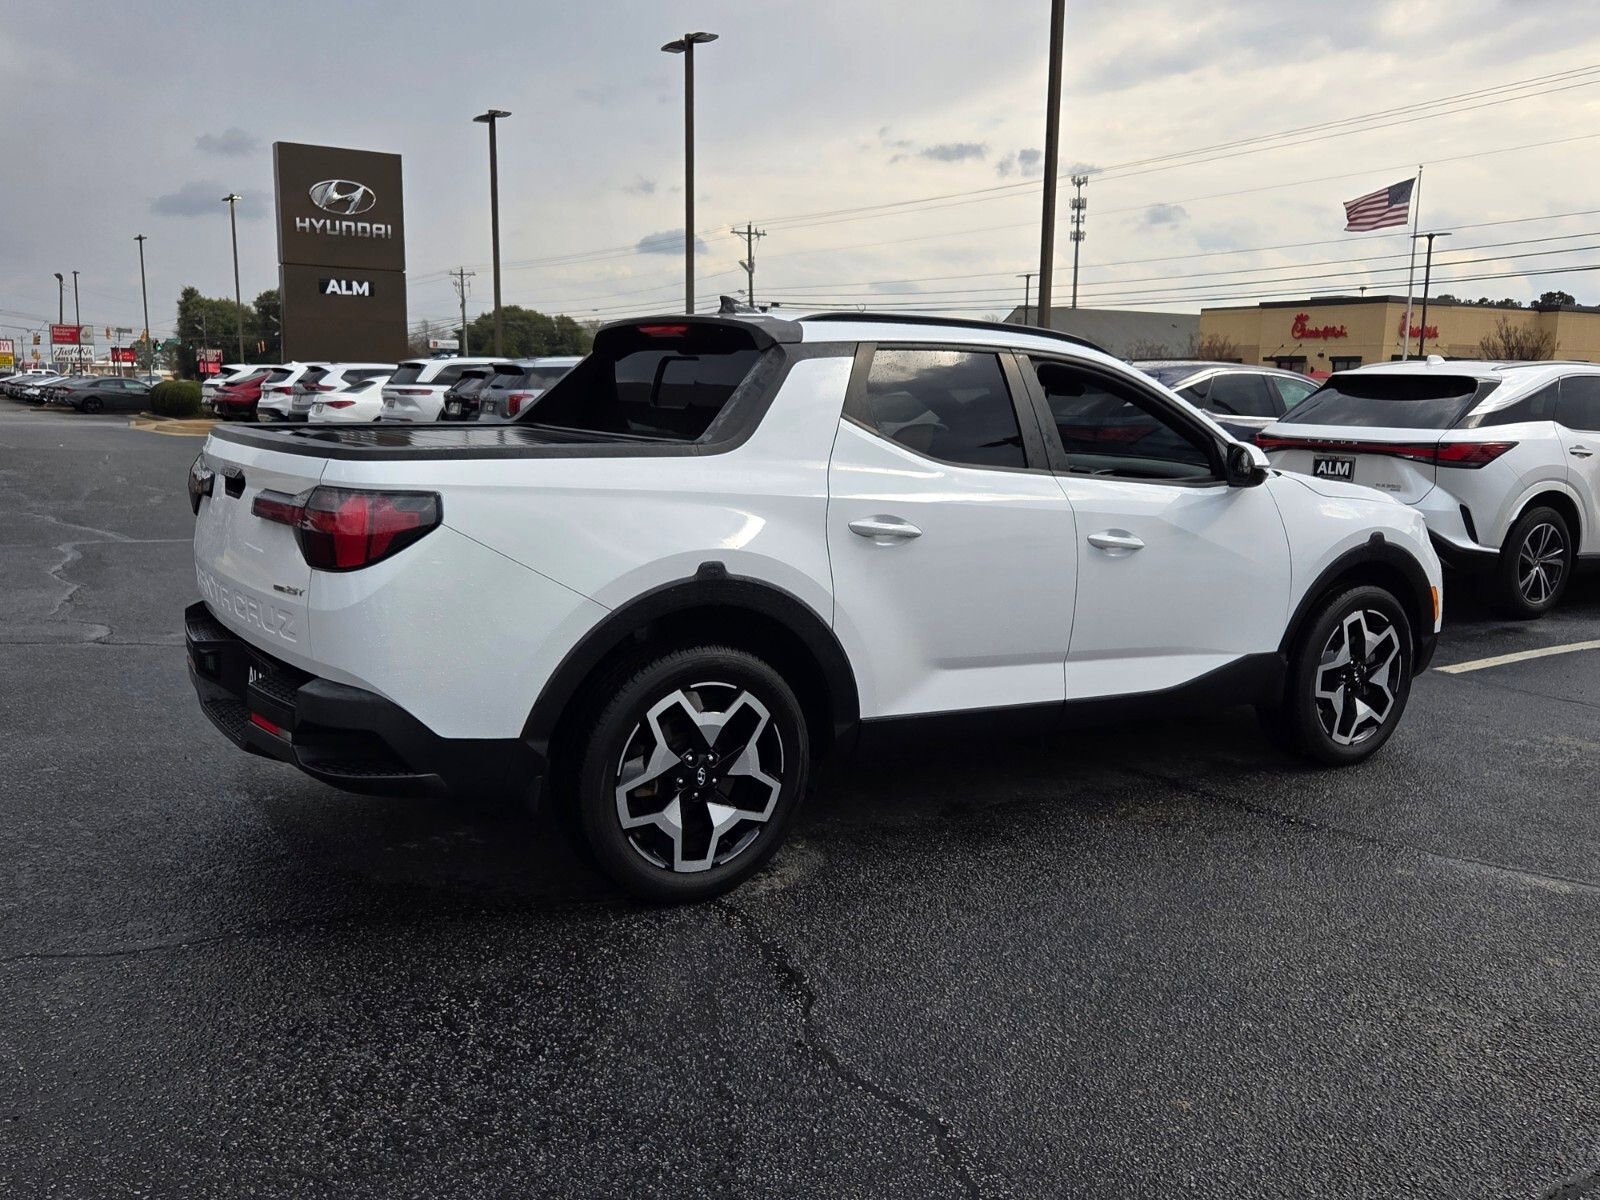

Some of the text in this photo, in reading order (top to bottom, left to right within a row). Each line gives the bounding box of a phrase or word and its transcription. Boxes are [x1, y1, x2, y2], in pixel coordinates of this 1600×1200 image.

[295, 217, 392, 239] HYUNDAI
[325, 279, 370, 296] ALM
[1316, 460, 1350, 476] ALM
